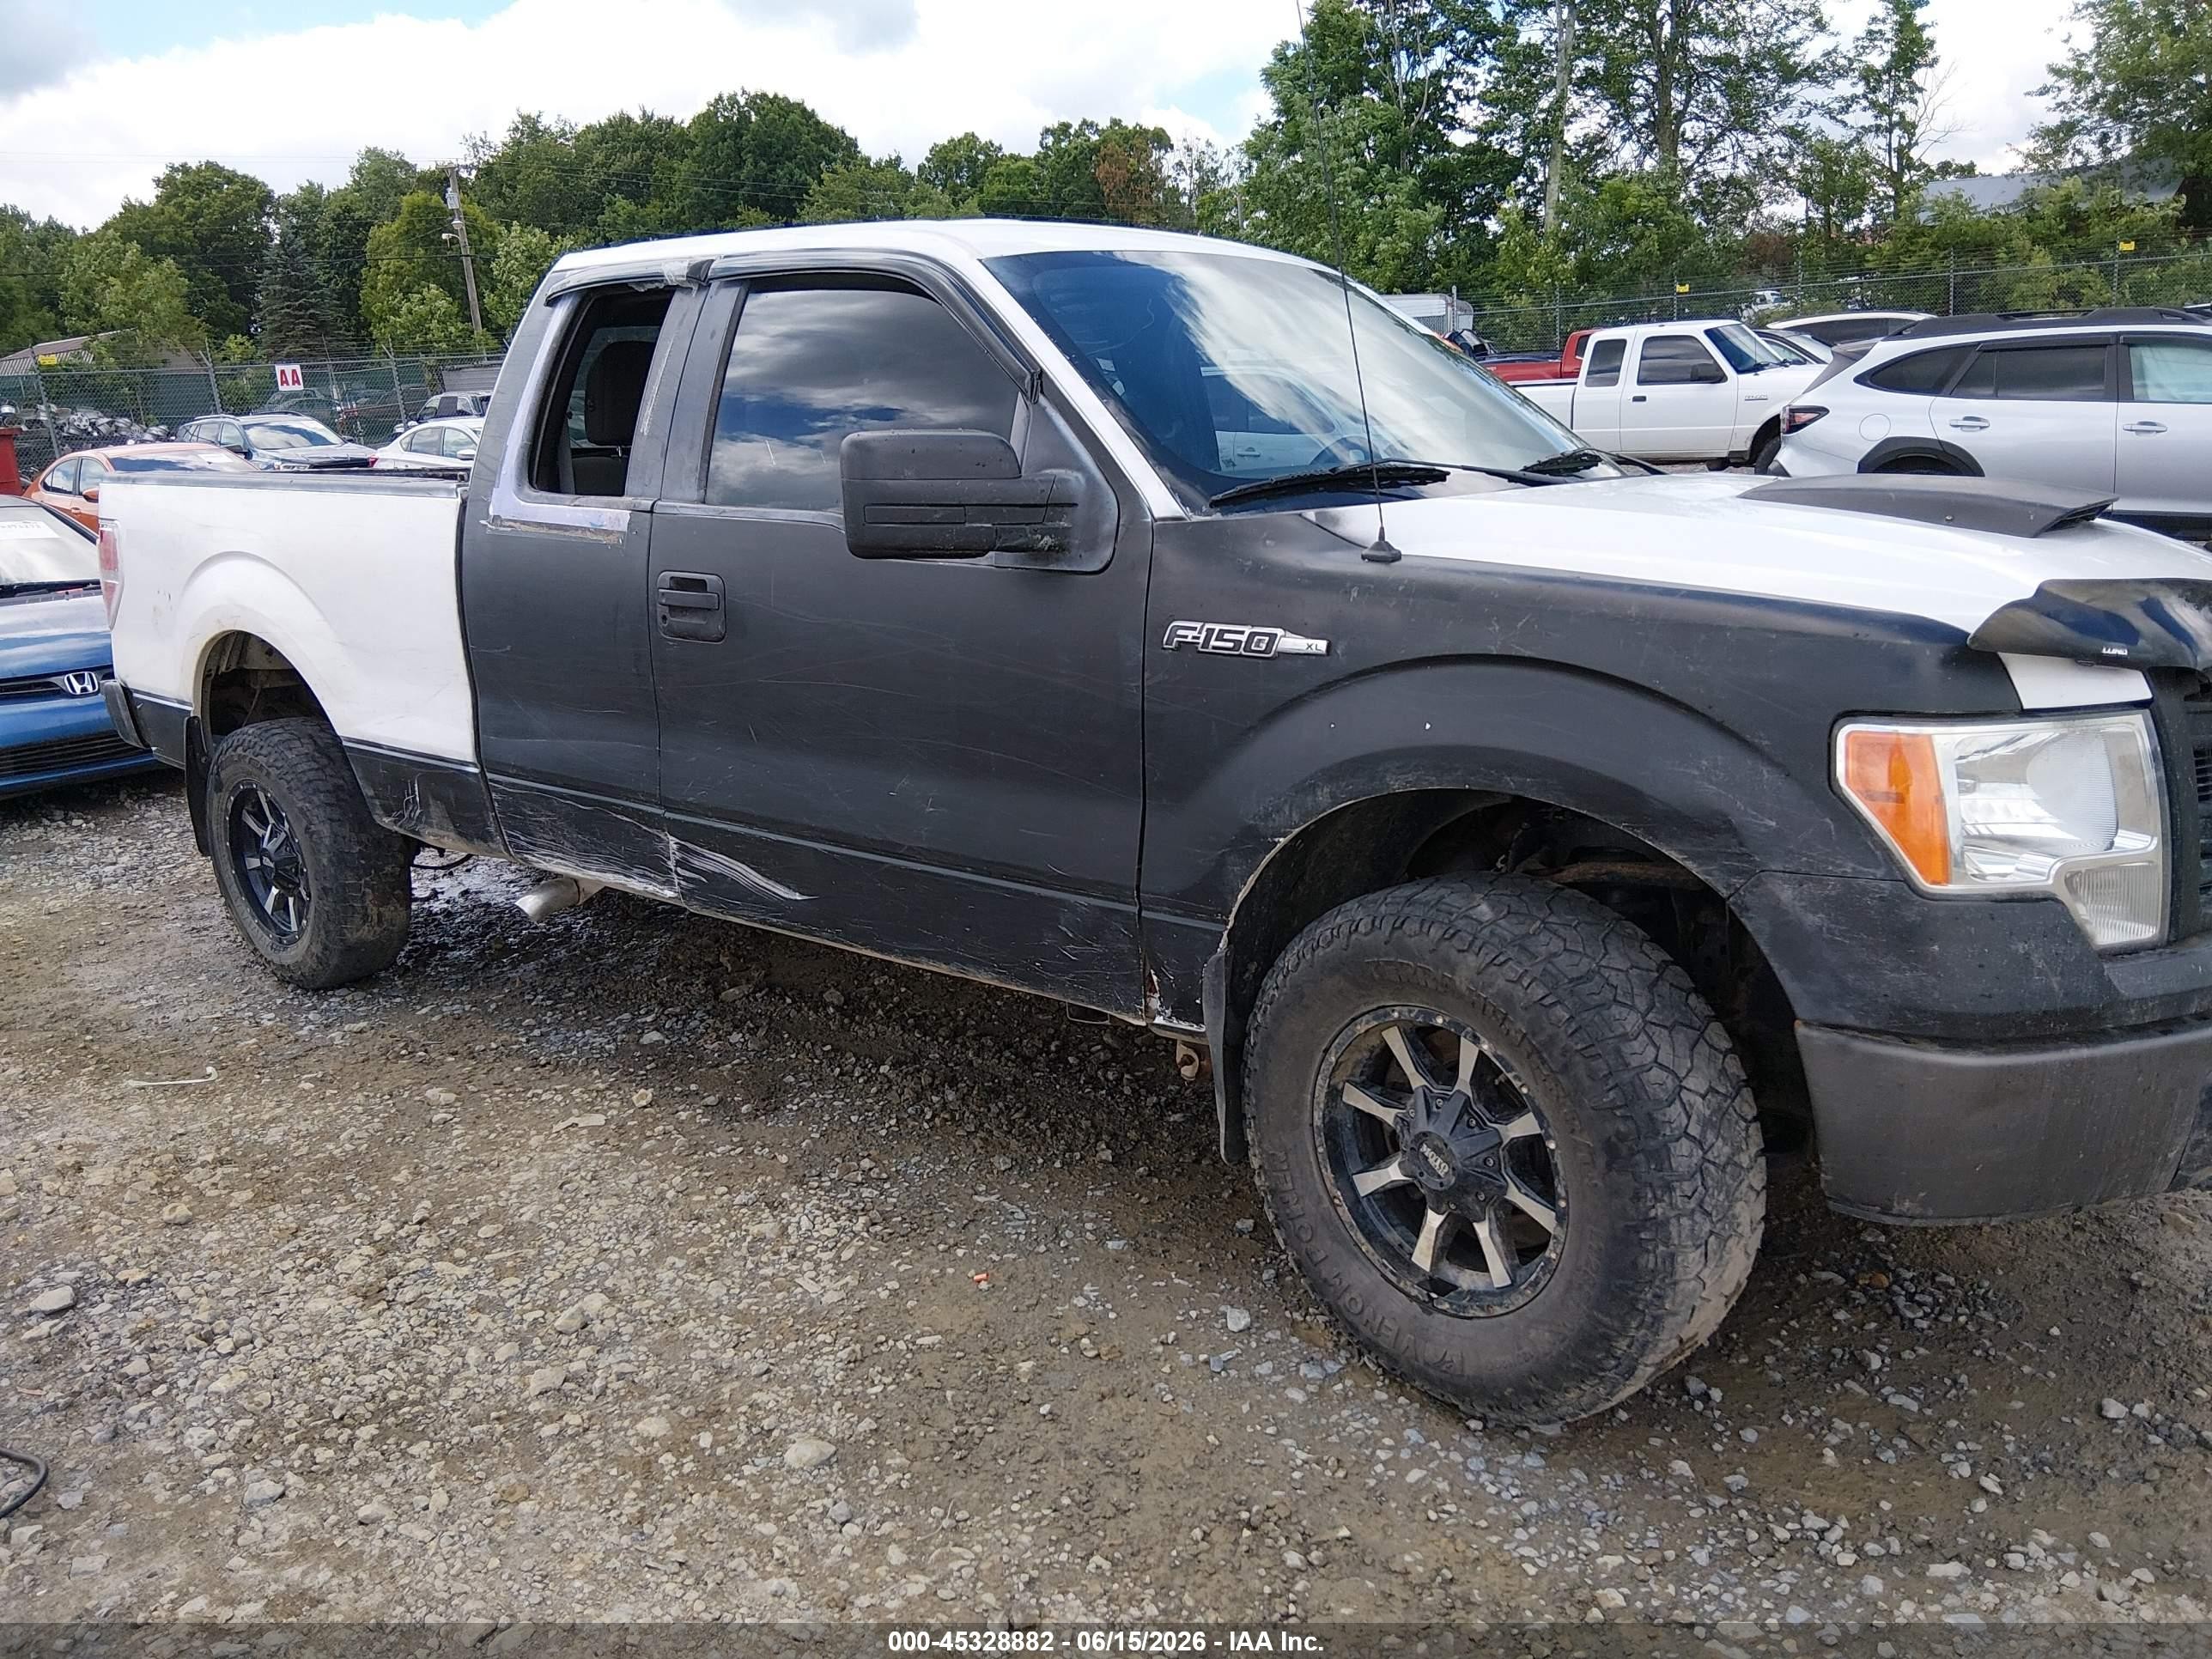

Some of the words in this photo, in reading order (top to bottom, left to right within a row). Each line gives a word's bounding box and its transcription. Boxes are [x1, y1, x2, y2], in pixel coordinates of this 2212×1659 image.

[279, 368, 302, 386] AA
[1163, 620, 1285, 659] F-150
[1305, 641, 1323, 652] XL
[1419, 1142, 1449, 1174] MOTO
